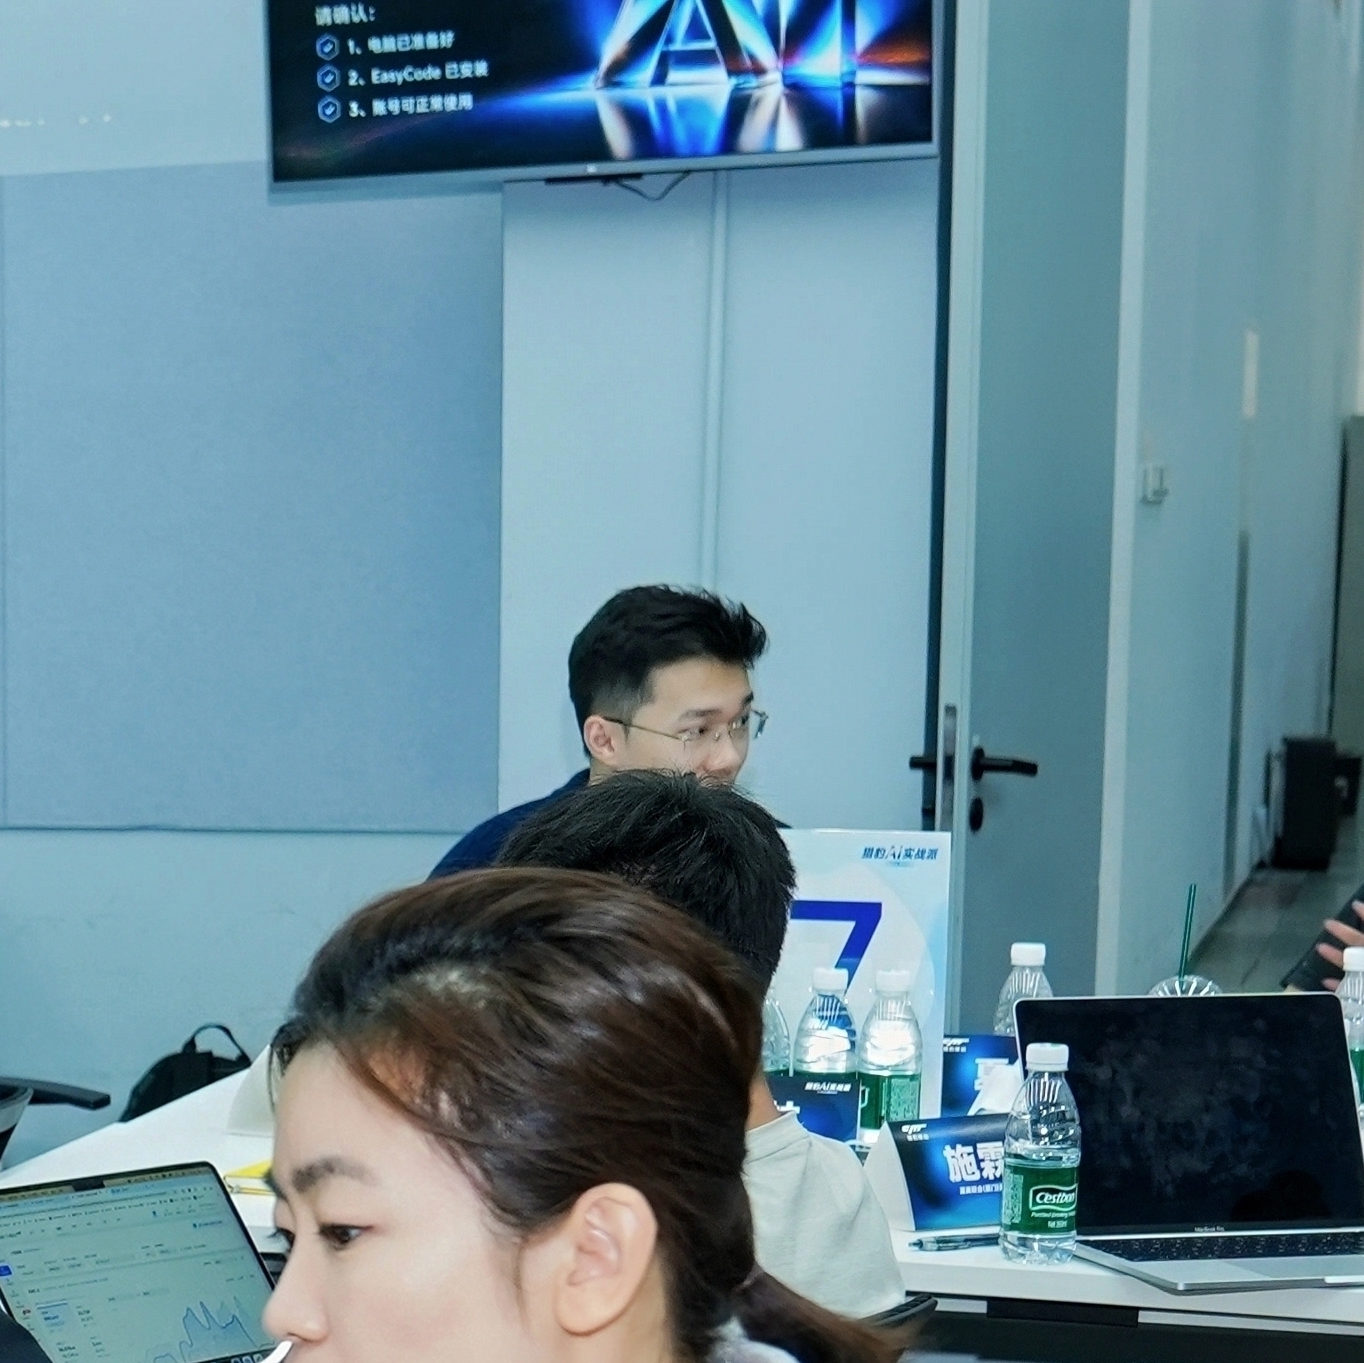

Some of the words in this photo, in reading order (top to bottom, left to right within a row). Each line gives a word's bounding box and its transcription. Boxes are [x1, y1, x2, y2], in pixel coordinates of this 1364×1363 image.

[861, 846, 939, 861] 猎豹AI实战派
[790, 900, 882, 993] 7
